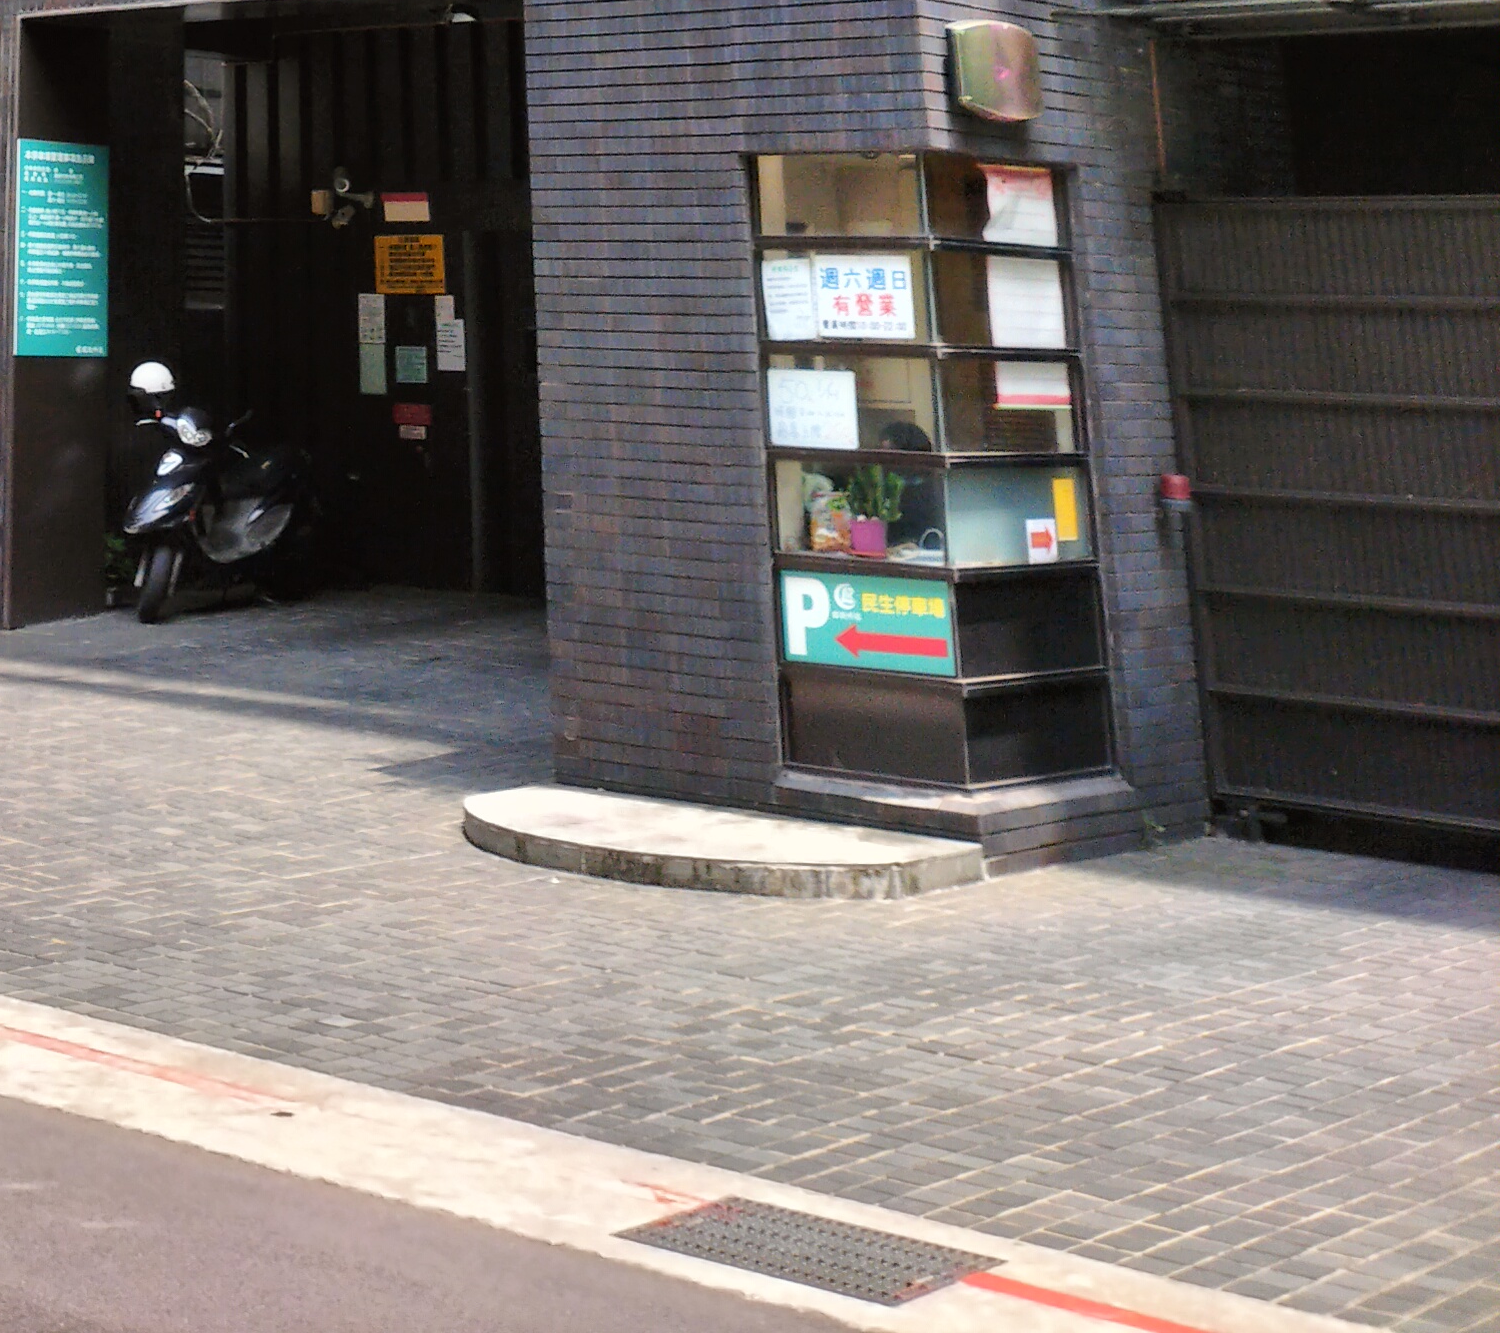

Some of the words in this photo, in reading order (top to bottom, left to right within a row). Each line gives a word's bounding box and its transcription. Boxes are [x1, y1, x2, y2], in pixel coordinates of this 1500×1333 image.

[820, 267, 907, 290] 週六週日
[833, 293, 897, 317] 有營業
[784, 576, 831, 655] P
[861, 592, 945, 619] 民生停車場
